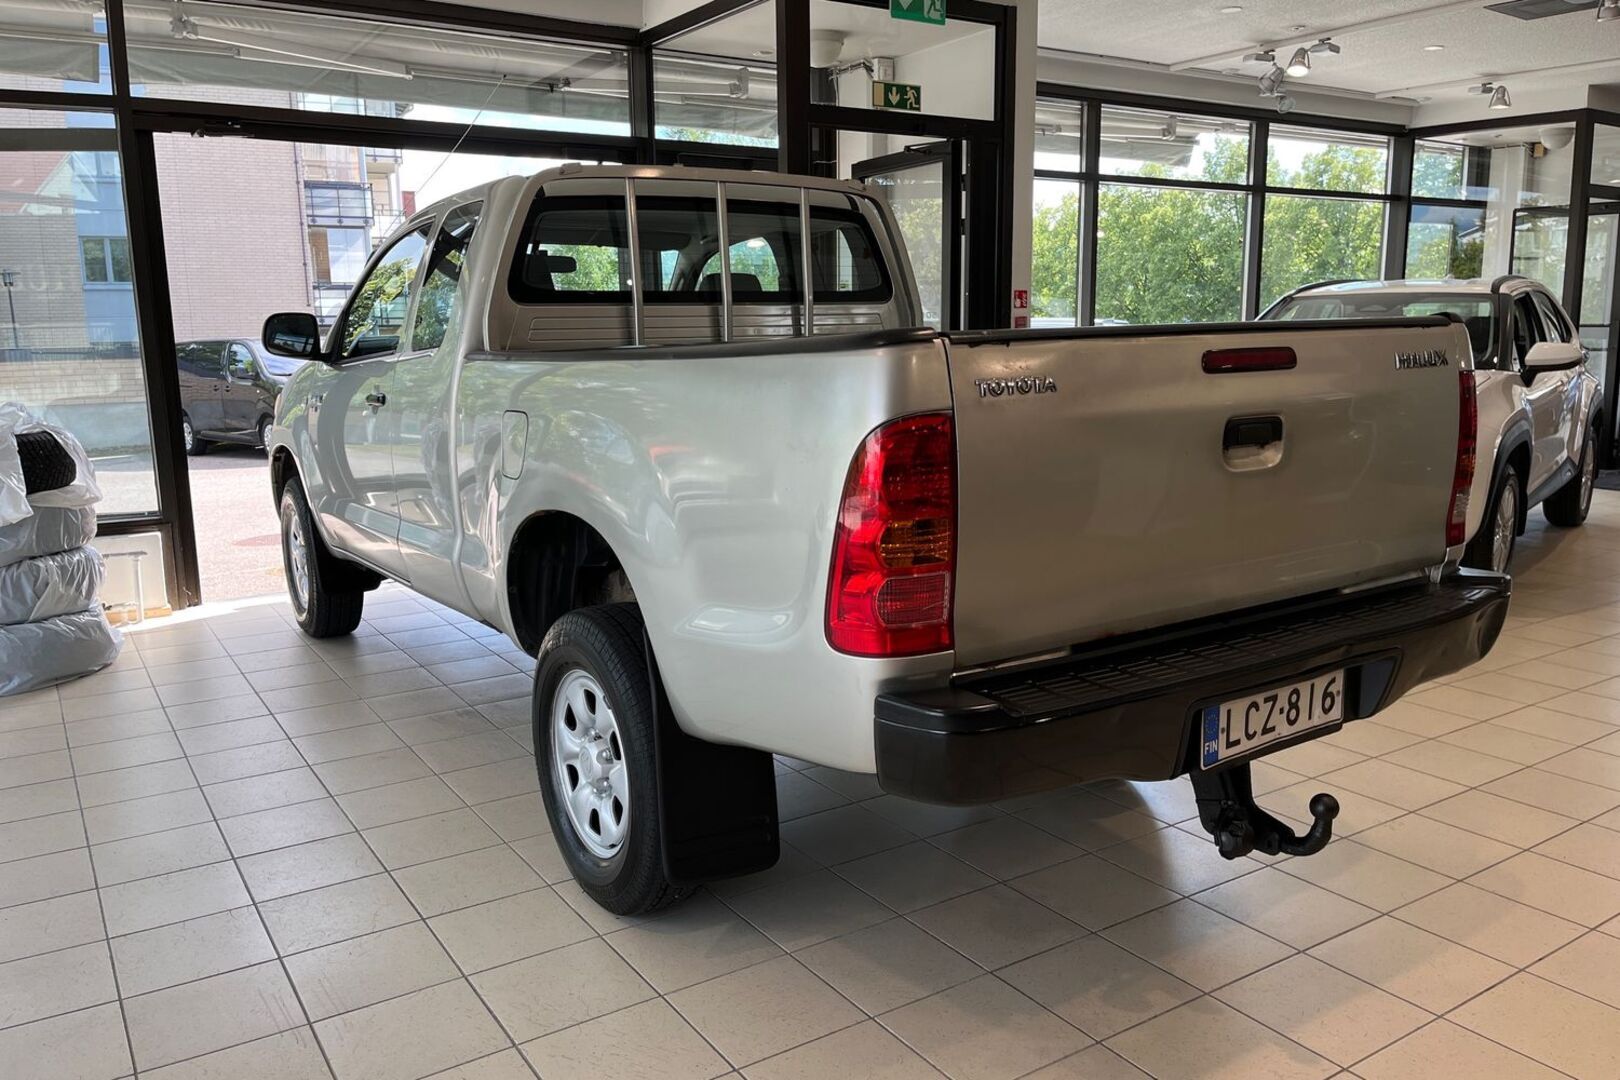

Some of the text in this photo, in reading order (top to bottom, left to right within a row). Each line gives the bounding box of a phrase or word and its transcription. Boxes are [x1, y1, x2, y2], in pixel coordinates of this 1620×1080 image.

[1395, 350, 1449, 370] HILUX
[975, 376, 1057, 398] TOYOTA
[1225, 676, 1337, 750] LCZ-816
[1204, 739, 1219, 756] FIN
